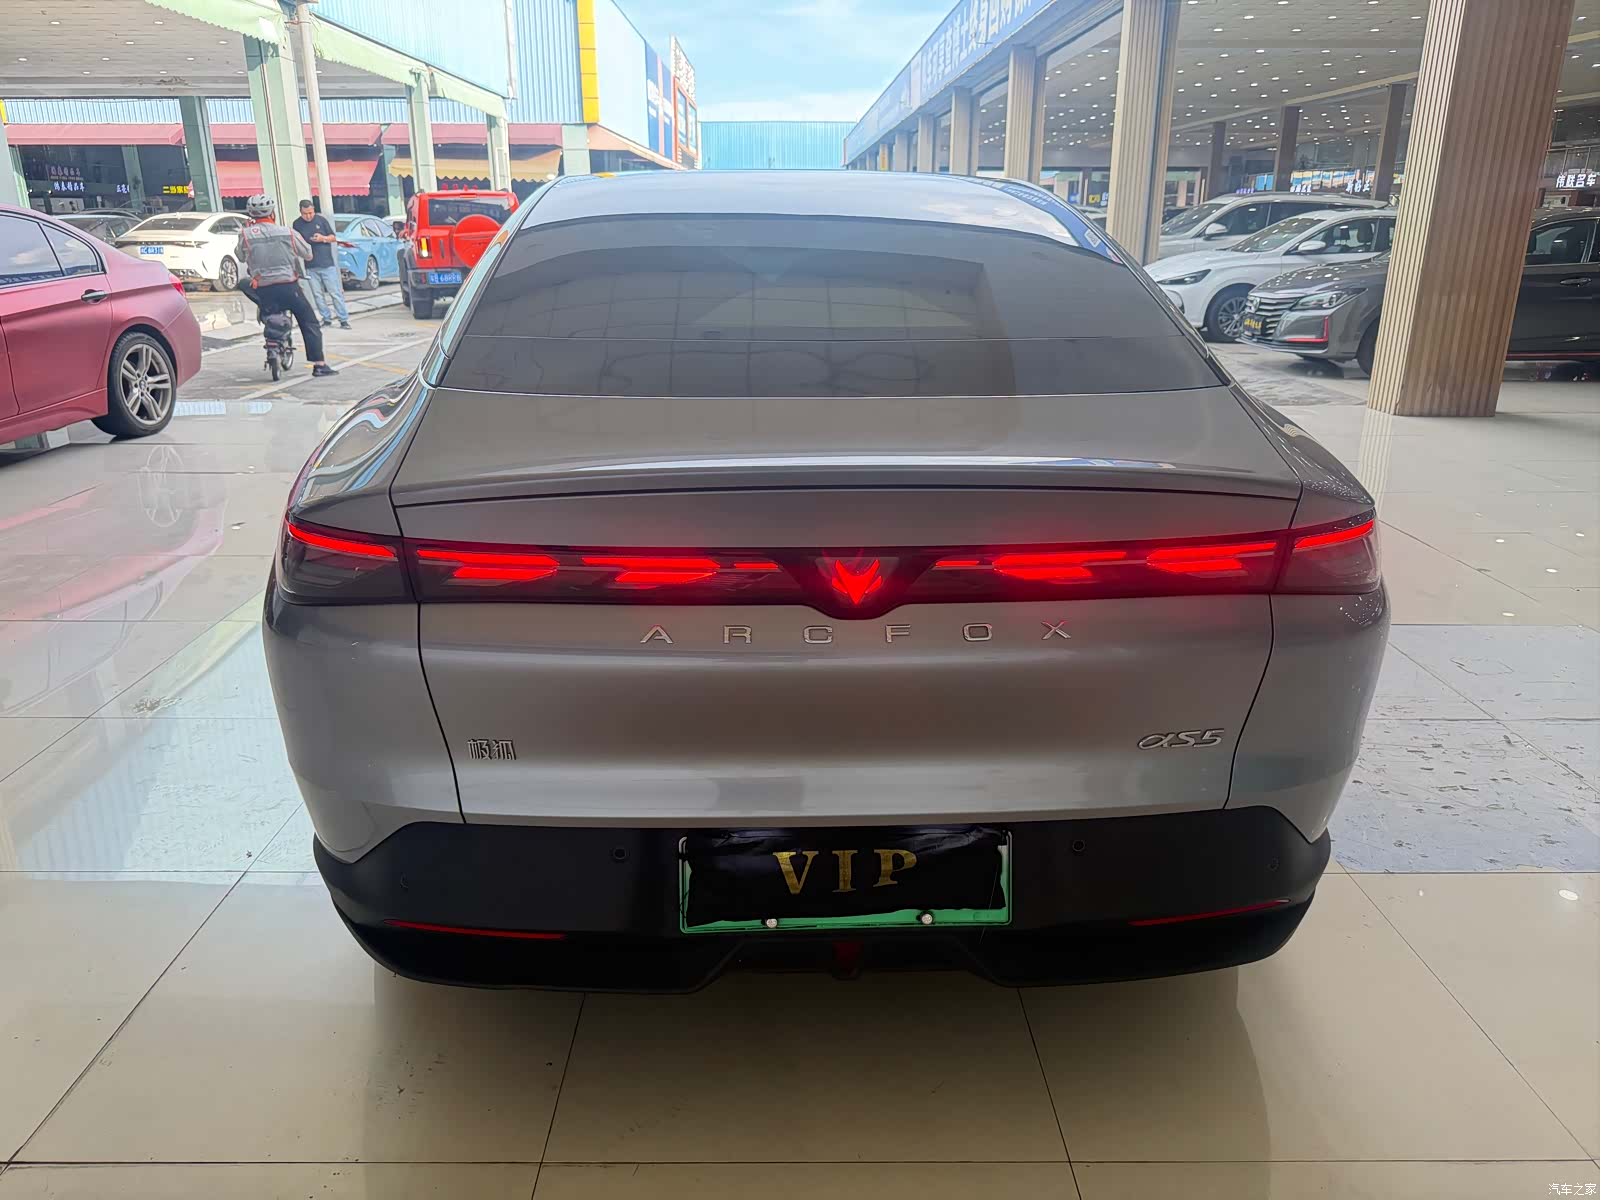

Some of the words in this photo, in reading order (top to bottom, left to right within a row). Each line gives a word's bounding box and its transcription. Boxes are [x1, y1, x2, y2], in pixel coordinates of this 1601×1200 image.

[640, 620, 1072, 645] ARCFOX
[467, 738, 516, 760] 极狐
[773, 848, 918, 895] VIP
